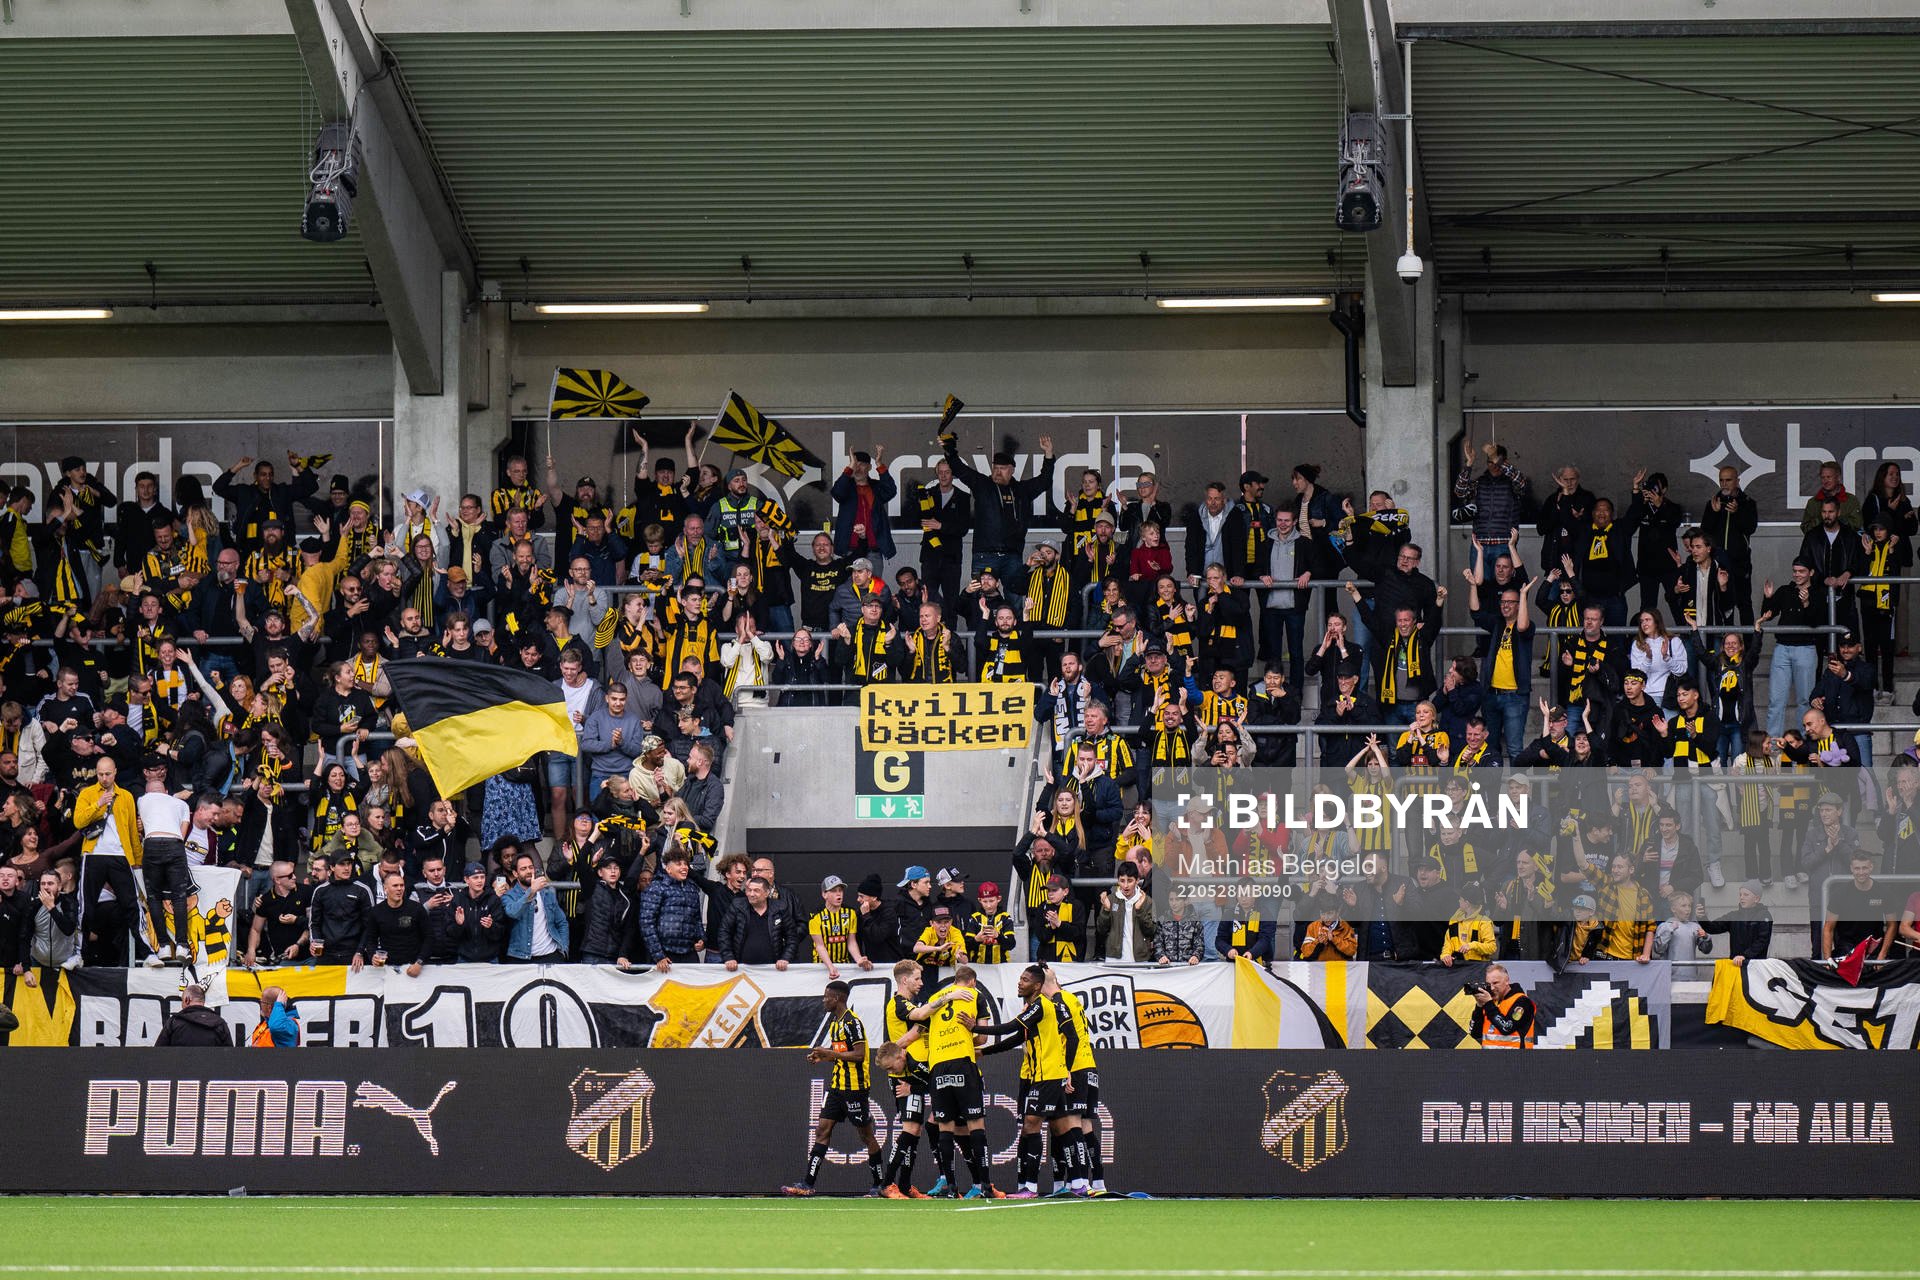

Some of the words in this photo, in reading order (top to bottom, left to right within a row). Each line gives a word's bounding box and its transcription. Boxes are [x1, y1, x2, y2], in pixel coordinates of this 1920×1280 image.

[868, 692, 1026, 717] kville
[868, 719, 1026, 744] bäcken
[873, 750, 910, 793] G
[941, 999, 954, 1021] 3
[84, 1080, 346, 1155] PUMA
[1422, 1102, 1512, 1142] FRÅN
[1523, 1102, 1690, 1142] HISINGEN
[1733, 1102, 1799, 1142] FÖR
[1808, 1102, 1894, 1142] ALLA
